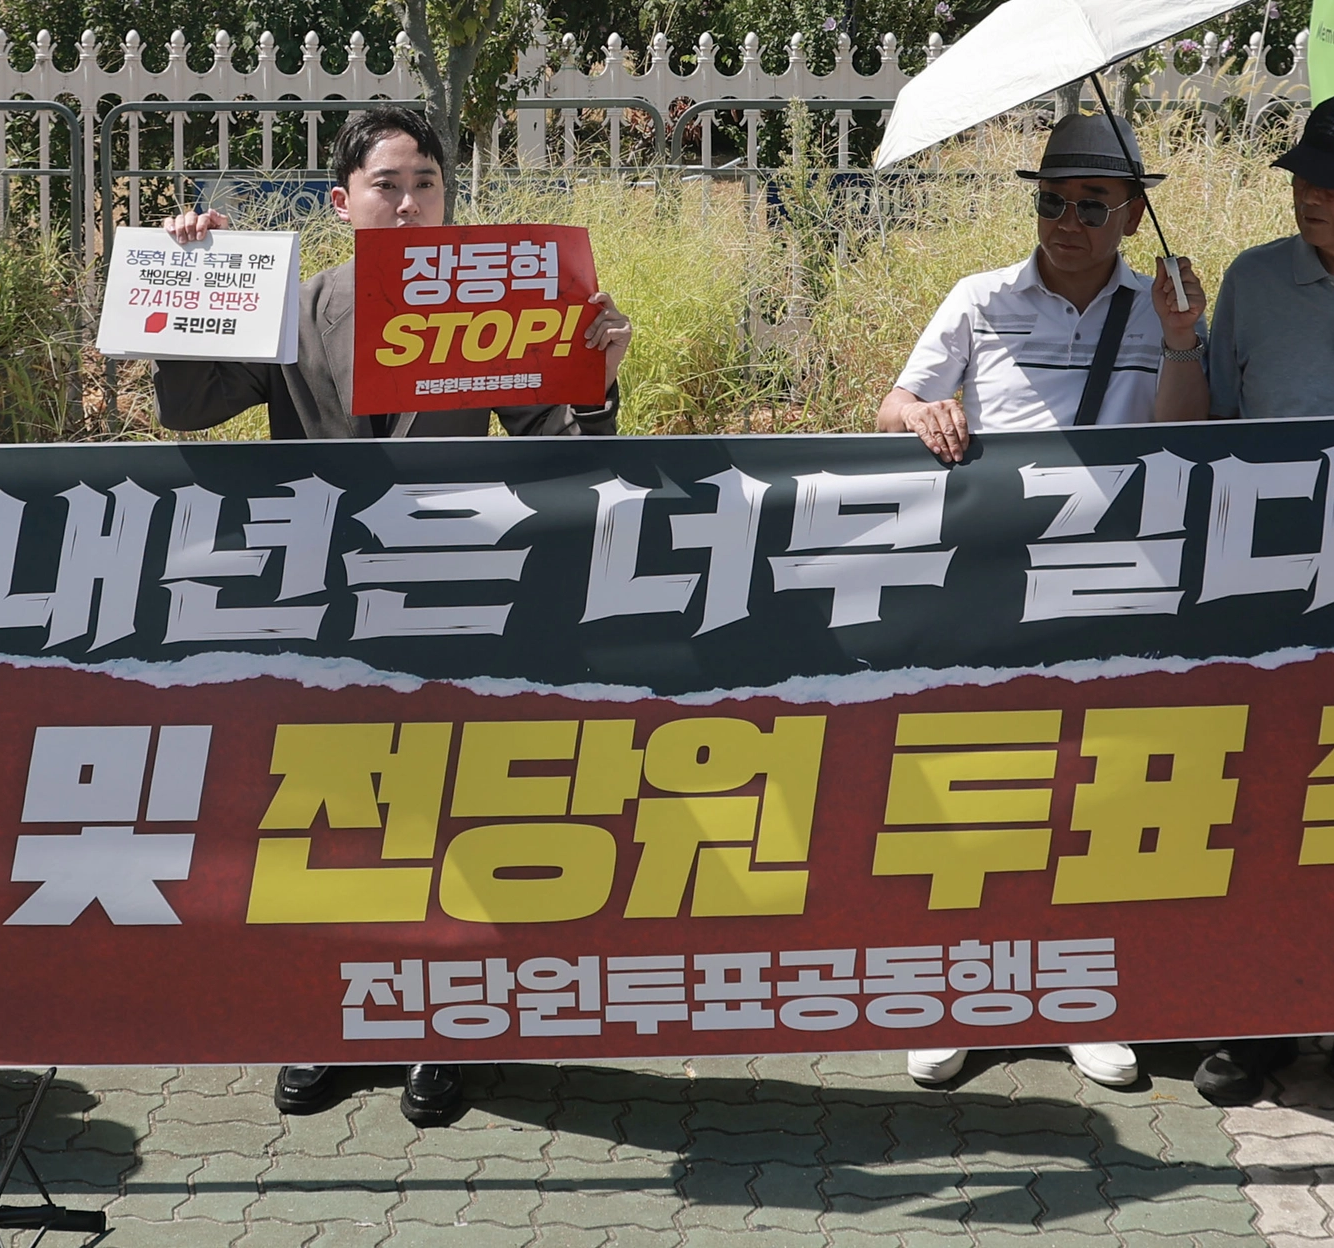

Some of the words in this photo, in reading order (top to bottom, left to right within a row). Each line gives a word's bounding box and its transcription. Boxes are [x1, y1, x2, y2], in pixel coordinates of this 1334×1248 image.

[126, 249, 166, 267] 장동혁
[170, 251, 199, 268] 퇴진
[203, 252, 243, 269] 촉구를
[247, 253, 276, 270] 위한
[138, 268, 193, 287] 책임당원
[204, 271, 257, 289] 일반시민
[402, 241, 559, 307] 장동혁
[128, 287, 201, 310] 27,415명
[209, 291, 261, 312] 연판장
[172, 315, 237, 336] 국민의힘
[375, 305, 582, 367] STOP!
[415, 373, 543, 396] 전당원투표공동행동
[579, 465, 957, 637] 너무
[3, 725, 212, 926] 및
[246, 715, 826, 924] 전당원
[872, 704, 1250, 910] 투표
[340, 937, 1119, 1040] 전당원투표공동행동
